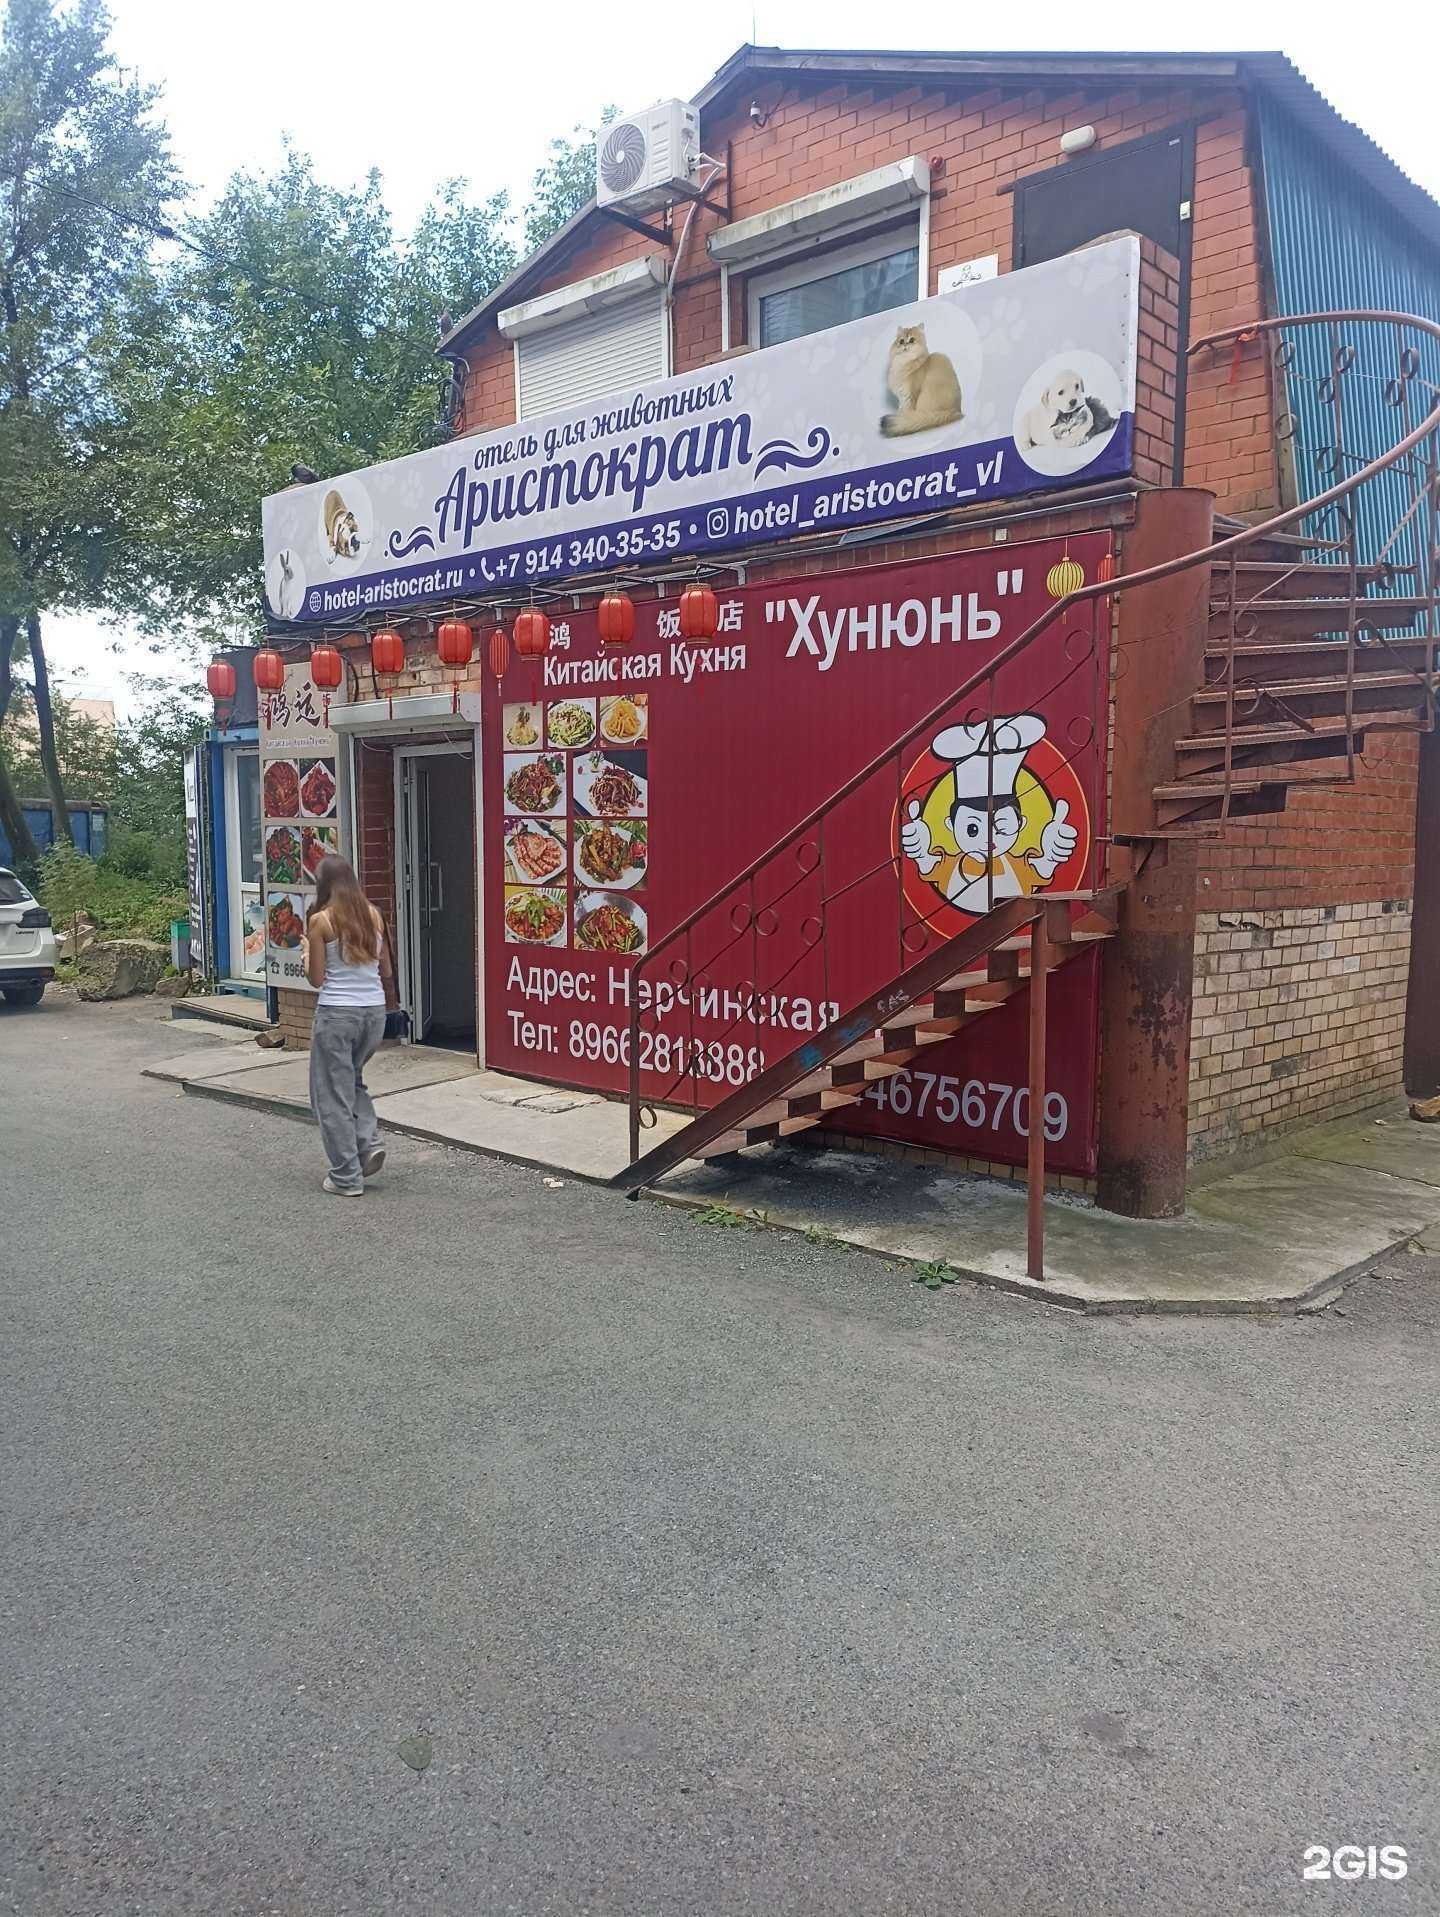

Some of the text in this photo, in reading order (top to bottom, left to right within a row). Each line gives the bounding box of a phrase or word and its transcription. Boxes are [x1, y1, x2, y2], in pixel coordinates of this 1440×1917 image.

[474, 374, 734, 471] отель для животных
[434, 412, 752, 549] Аристократ
[323, 451, 1004, 612] hotel-aristocrat.ru +7 914 340-35-35 hotel_aristocrat_vl
[765, 568, 1024, 671] "Хунюнь"
[544, 642, 746, 686] Китайская Кухня
[284, 962, 306, 978] 8966
[506, 955, 597, 1005] Адрес:
[507, 1009, 559, 1054] Тел:
